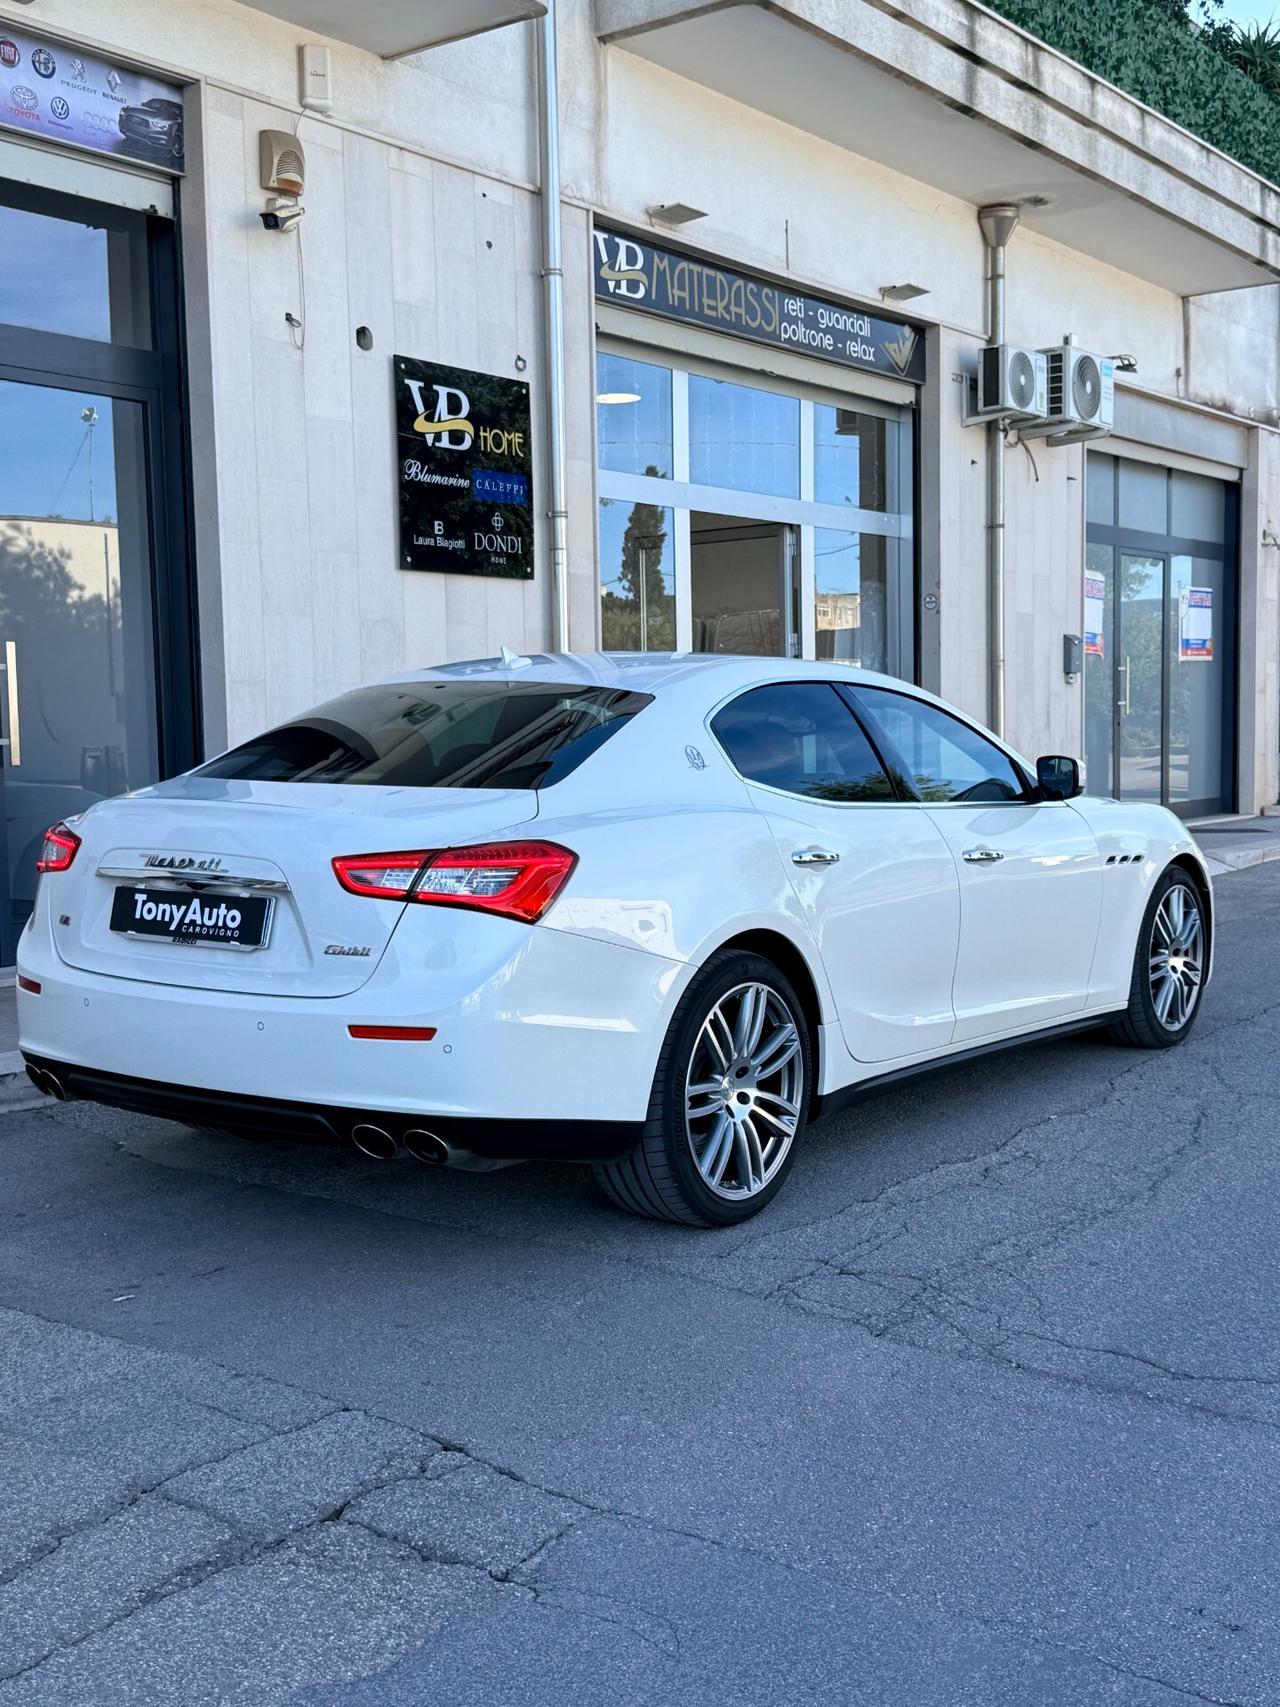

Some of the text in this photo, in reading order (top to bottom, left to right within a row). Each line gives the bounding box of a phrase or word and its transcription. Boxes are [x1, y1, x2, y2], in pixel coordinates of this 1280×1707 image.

[61, 79, 97, 95] PEUGEOT
[102, 91, 127, 104] RENAULT
[9, 106, 41, 122] TOYOTA
[652, 251, 780, 335] MATERASSI
[784, 297, 804, 318] reti
[817, 308, 871, 338] guanciali
[781, 320, 834, 350] poltrone
[846, 337, 875, 362] relax
[480, 426, 524, 457] HOME
[404, 459, 470, 488] Blumarine
[475, 479, 523, 495] CALEFFI
[413, 534, 466, 550] Laura Biagiotti
[474, 532, 522, 554] DONDI
[490, 556, 507, 565] HOME
[182, 925, 240, 937] CAROVIGNO
[324, 944, 371, 956] Ghibli
